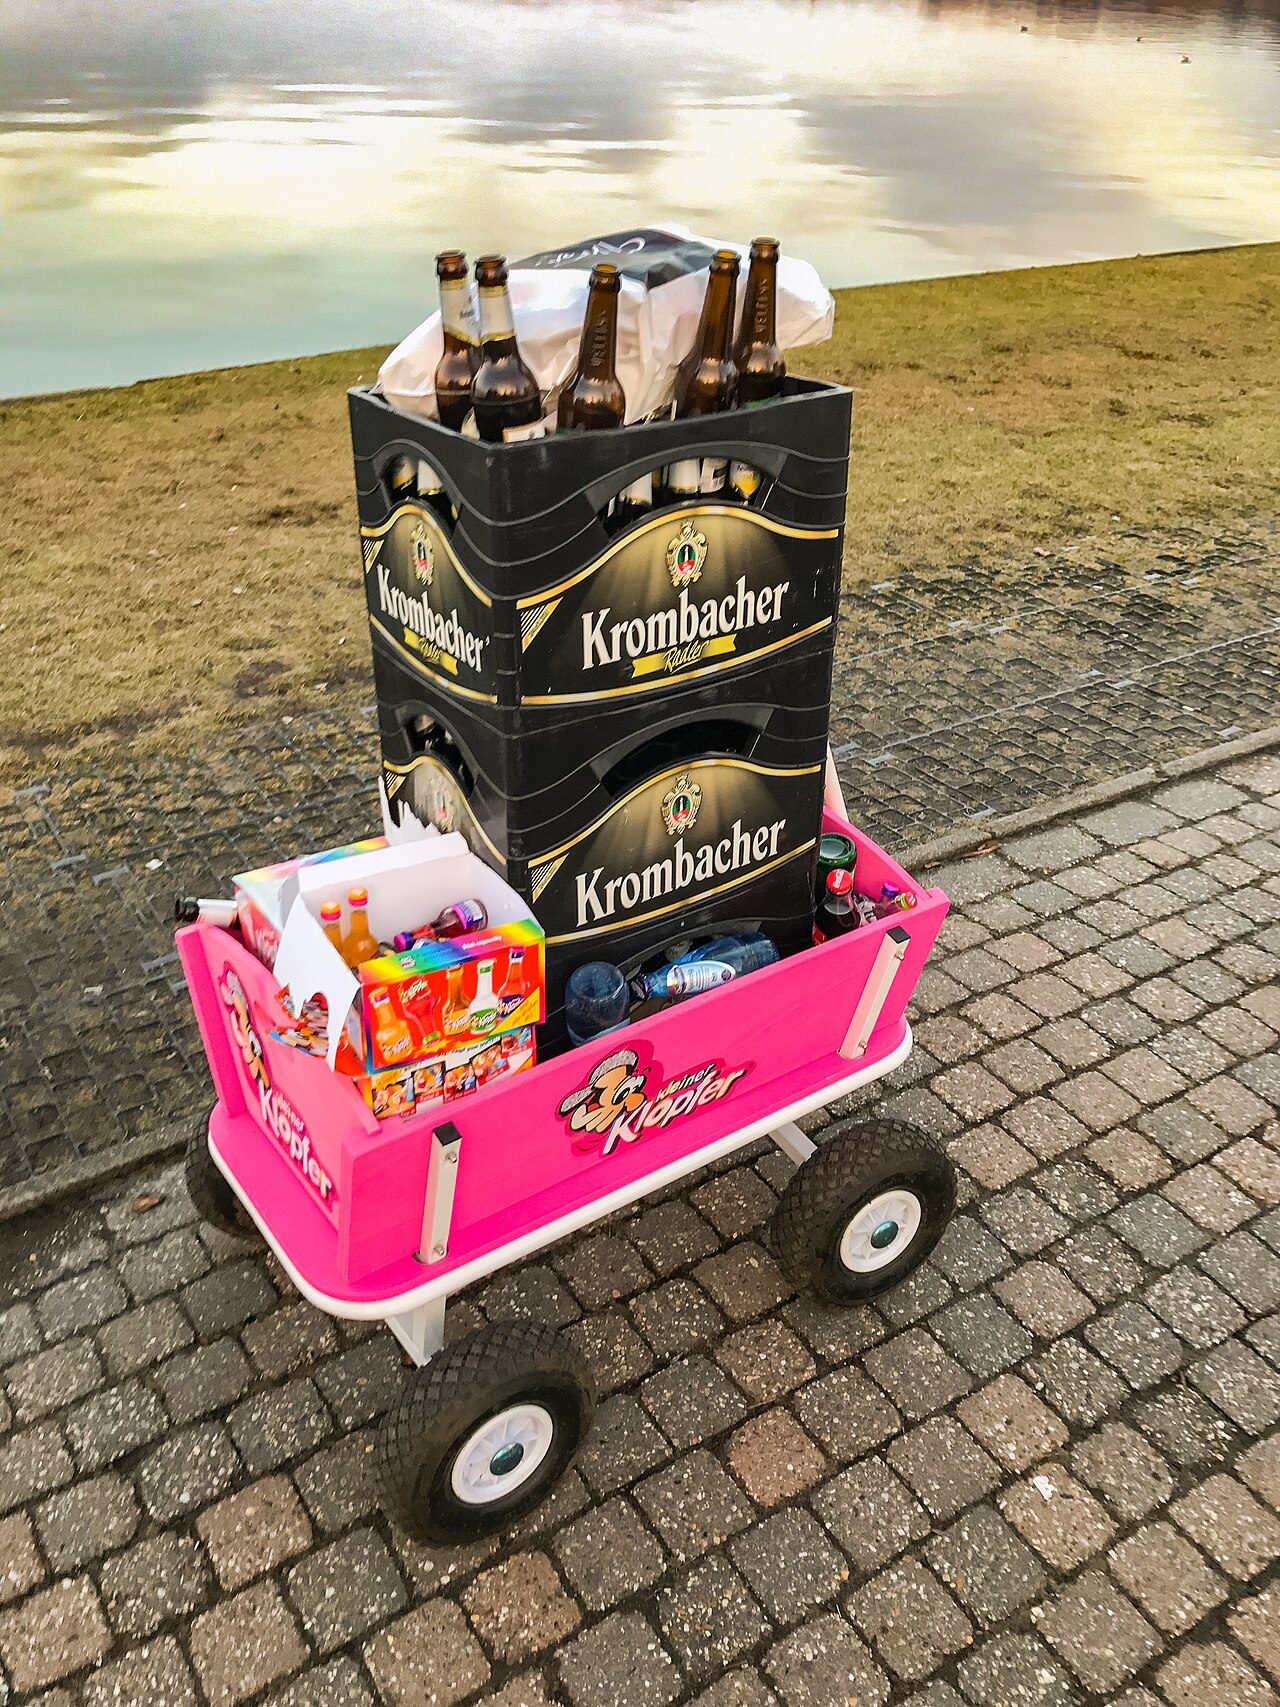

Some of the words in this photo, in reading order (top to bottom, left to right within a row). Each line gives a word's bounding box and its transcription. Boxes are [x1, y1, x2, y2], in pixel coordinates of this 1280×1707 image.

[376, 563, 484, 674] Krombacher
[581, 575, 790, 671] Krombacher
[662, 639, 710, 674] Radler
[575, 818, 787, 927] Krombacher
[603, 1068, 747, 1155] Klopfer
[656, 1063, 717, 1103] kleiner
[258, 1079, 333, 1199] Klopfer
